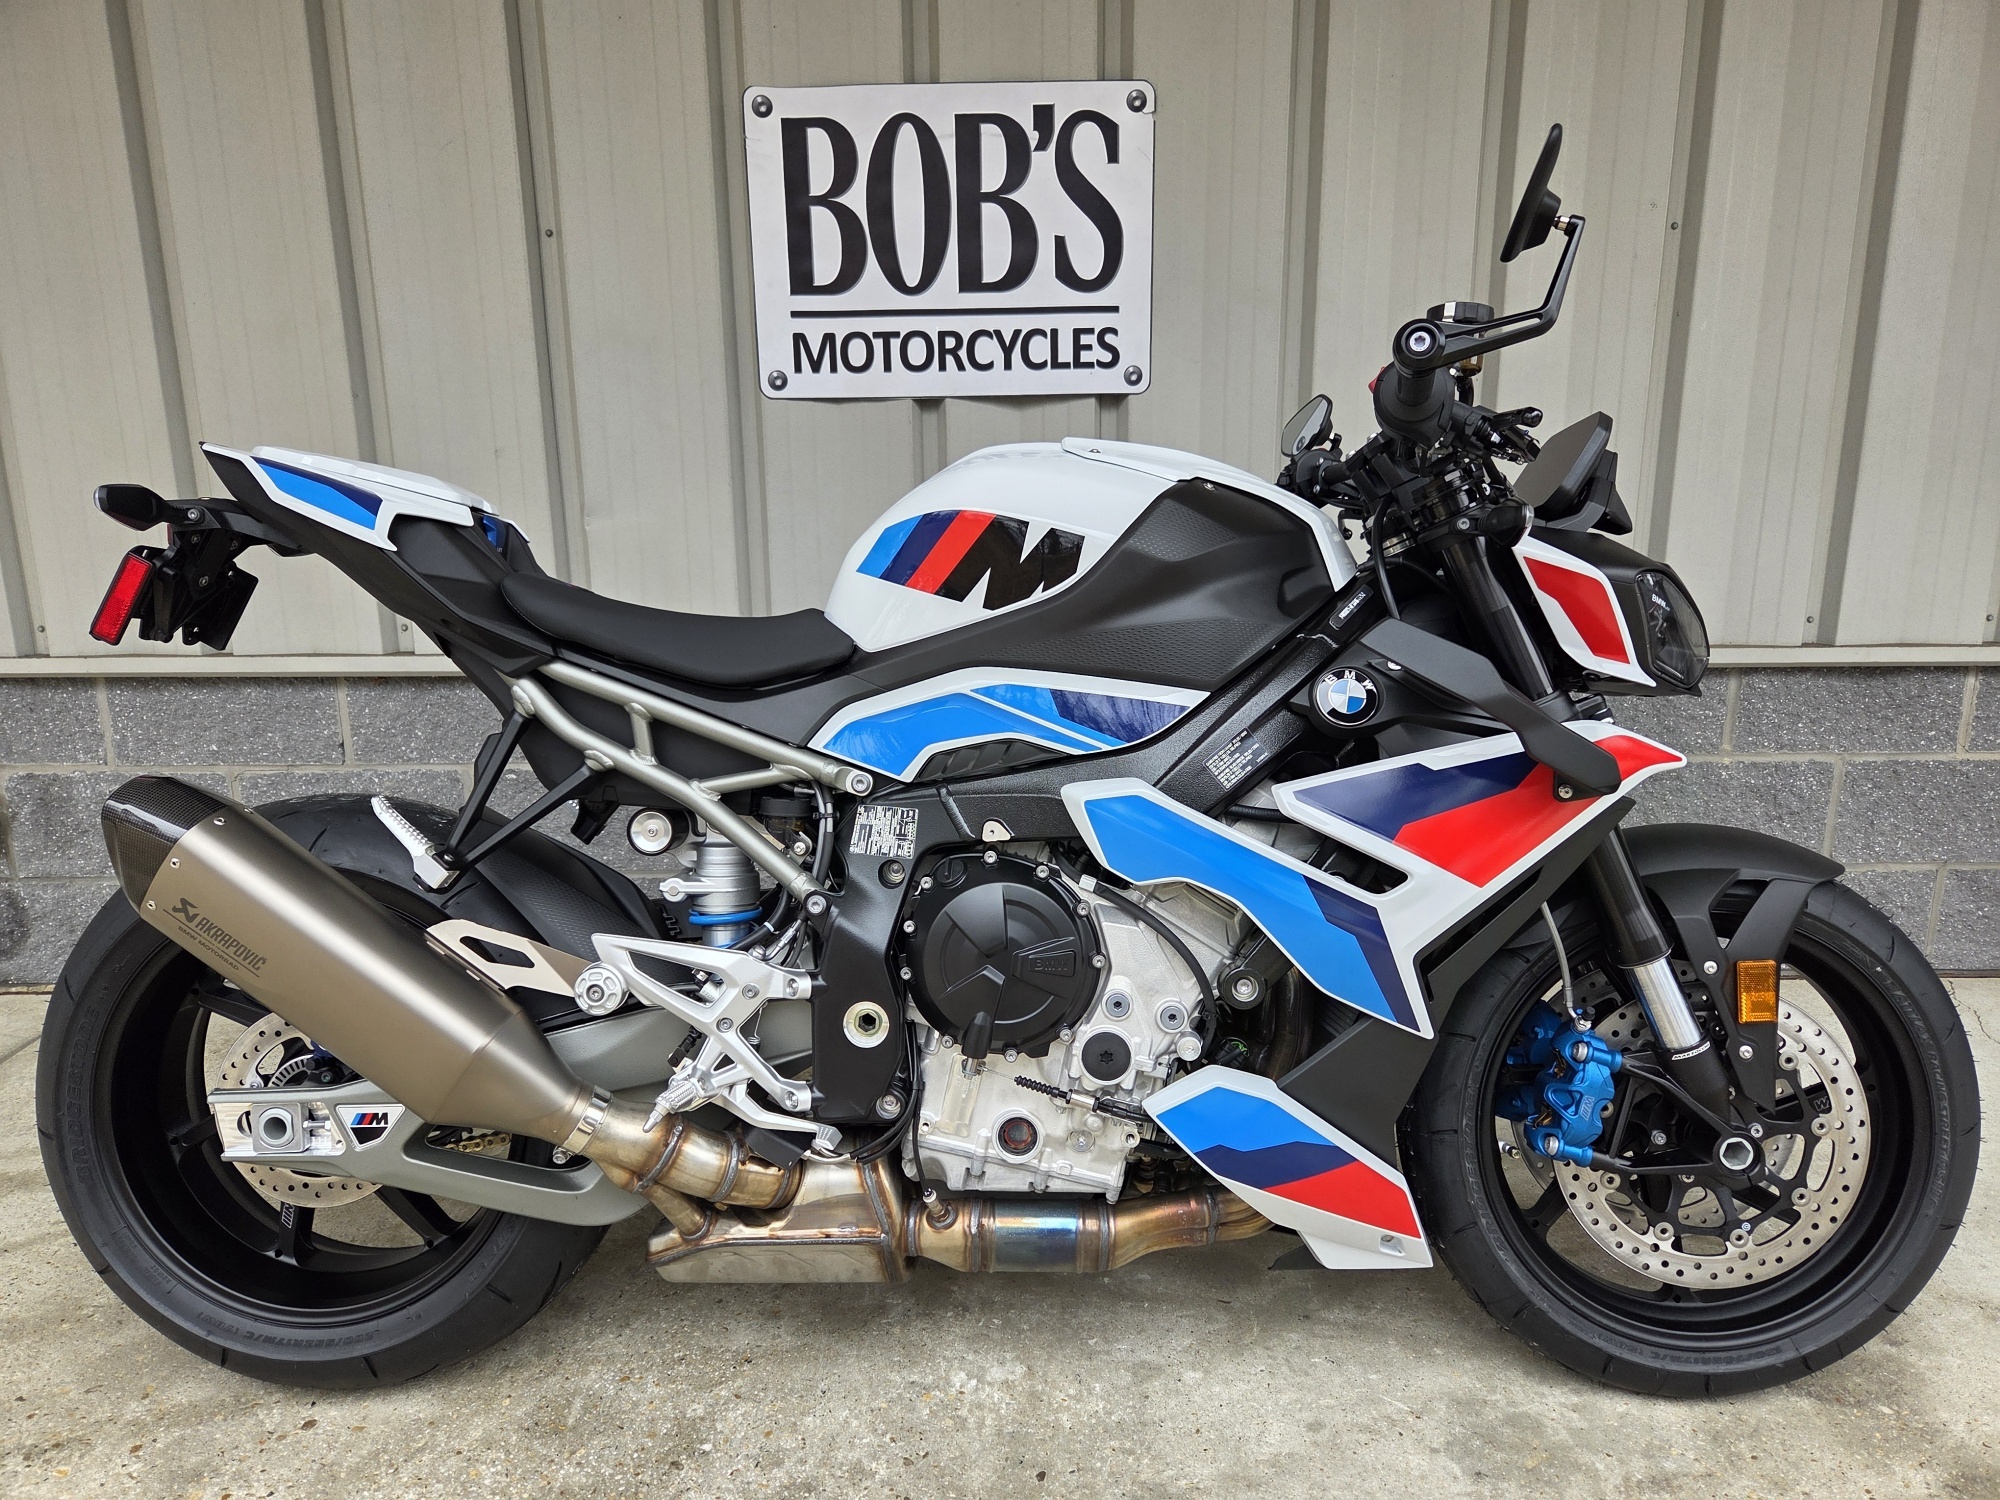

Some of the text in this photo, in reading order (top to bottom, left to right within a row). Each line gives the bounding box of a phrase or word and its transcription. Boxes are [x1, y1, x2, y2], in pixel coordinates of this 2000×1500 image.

[780, 103, 1124, 296] BOB'S
[792, 326, 1121, 373] MOTORCYCLES
[1652, 594, 1667, 608] BMW
[1324, 670, 1376, 691] BMW
[178, 926, 198, 941] BMW
[197, 940, 239, 971] MOTORRAD
[1035, 959, 1069, 971] BMW
[1926, 1051, 1947, 1104] RACING
[1938, 1102, 1949, 1154] STREET
